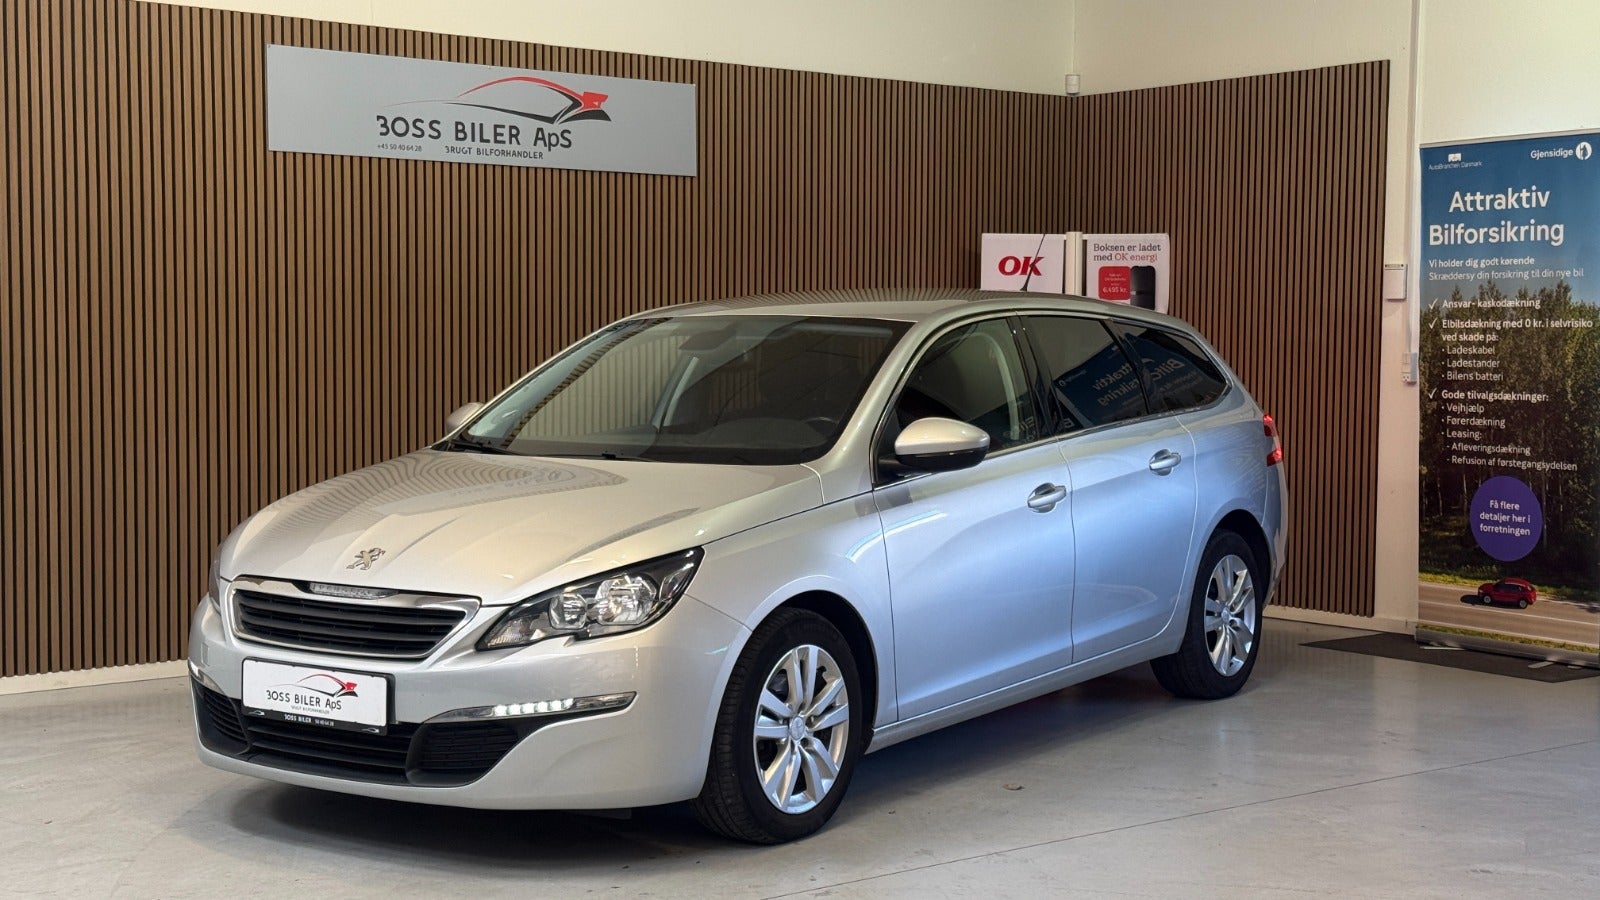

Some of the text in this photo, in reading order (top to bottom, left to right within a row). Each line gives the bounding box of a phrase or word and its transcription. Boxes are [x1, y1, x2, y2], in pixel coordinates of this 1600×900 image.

[454, 120, 521, 147] BILER
[534, 127, 572, 152] ApS
[476, 147, 544, 159] BILFORHANDLER
[1530, 148, 1574, 160] Gjensidige
[1449, 185, 1550, 212] Attraktiv
[1429, 218, 1564, 246] Bilforsikring
[1093, 244, 1124, 252] Boksen
[1139, 244, 1161, 252] ladet
[1093, 253, 1158, 263] med OK energi
[1429, 256, 1534, 269] Vi holder dig godt kørende
[998, 256, 1045, 276] OK
[1477, 270, 1490, 279] din
[1492, 270, 1529, 280] forsikring
[1532, 269, 1540, 278] til
[1542, 269, 1554, 277] din
[1556, 270, 1571, 279] nye
[1573, 268, 1584, 276] bil
[1442, 299, 1541, 309] Ansvar- kaskodækning
[1442, 319, 1593, 330] Elbilsdækning med 0 kr. i selvrisiko
[1442, 333, 1499, 343] ved skade på:
[1446, 346, 1495, 354] Ladeskabel
[1446, 359, 1500, 368] Ladestander
[1446, 372, 1504, 381] Bilens batteri
[1442, 390, 1549, 403] Gode tilvalgsdækninger:
[1446, 403, 1484, 413] Vejhjælp
[1446, 417, 1505, 428] Førerdækning
[1446, 430, 1482, 440] Leasing:
[1452, 443, 1530, 455] Afleveringsdækning
[1452, 456, 1578, 472] Refusion af førstegangsydelsen
[1490, 500, 1520, 510] Få flere
[1480, 512, 1530, 523] detaljer her i
[1480, 524, 1530, 536] forretningen
[294, 694, 320, 707] BILER
[325, 698, 342, 711] ApS
